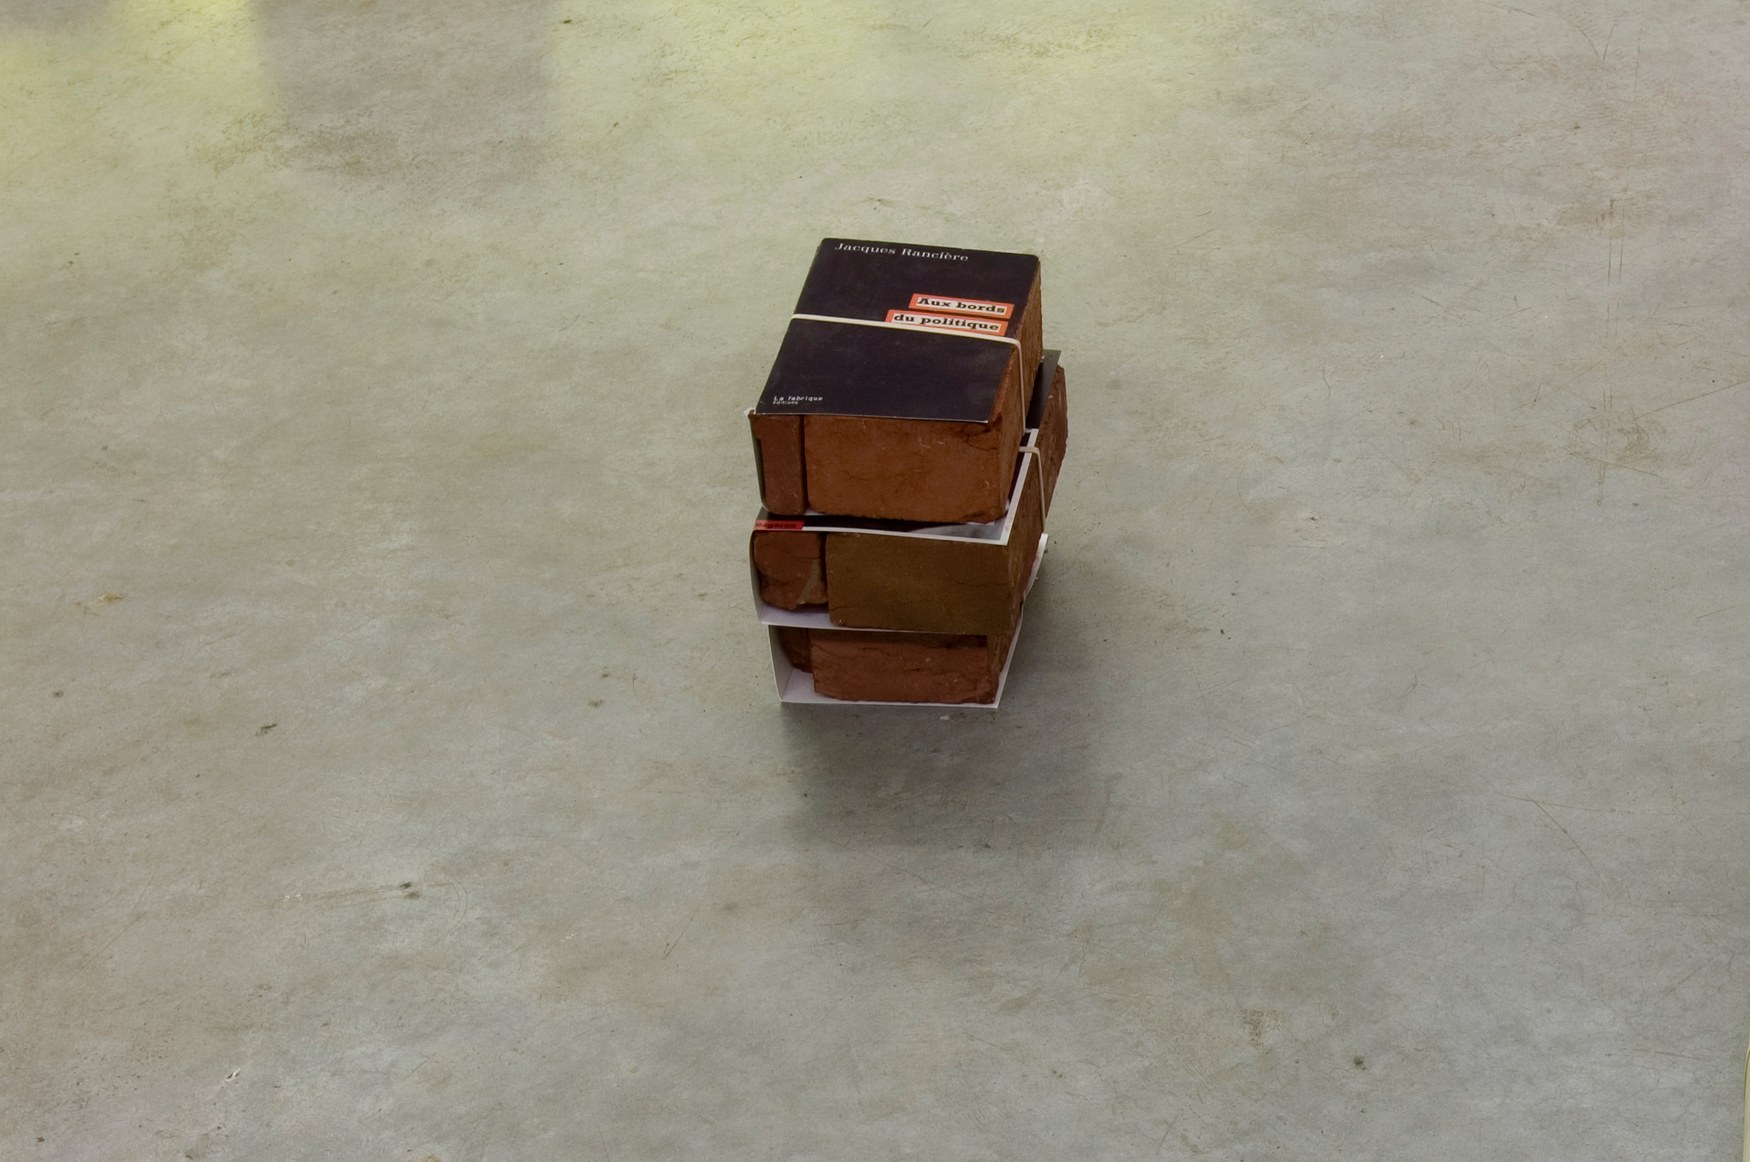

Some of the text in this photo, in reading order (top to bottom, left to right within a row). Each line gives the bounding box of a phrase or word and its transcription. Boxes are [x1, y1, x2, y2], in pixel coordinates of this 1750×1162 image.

[834, 243, 969, 262] Jacques Rancière
[918, 297, 1006, 314] Aux bords
[893, 314, 999, 331] du politique
